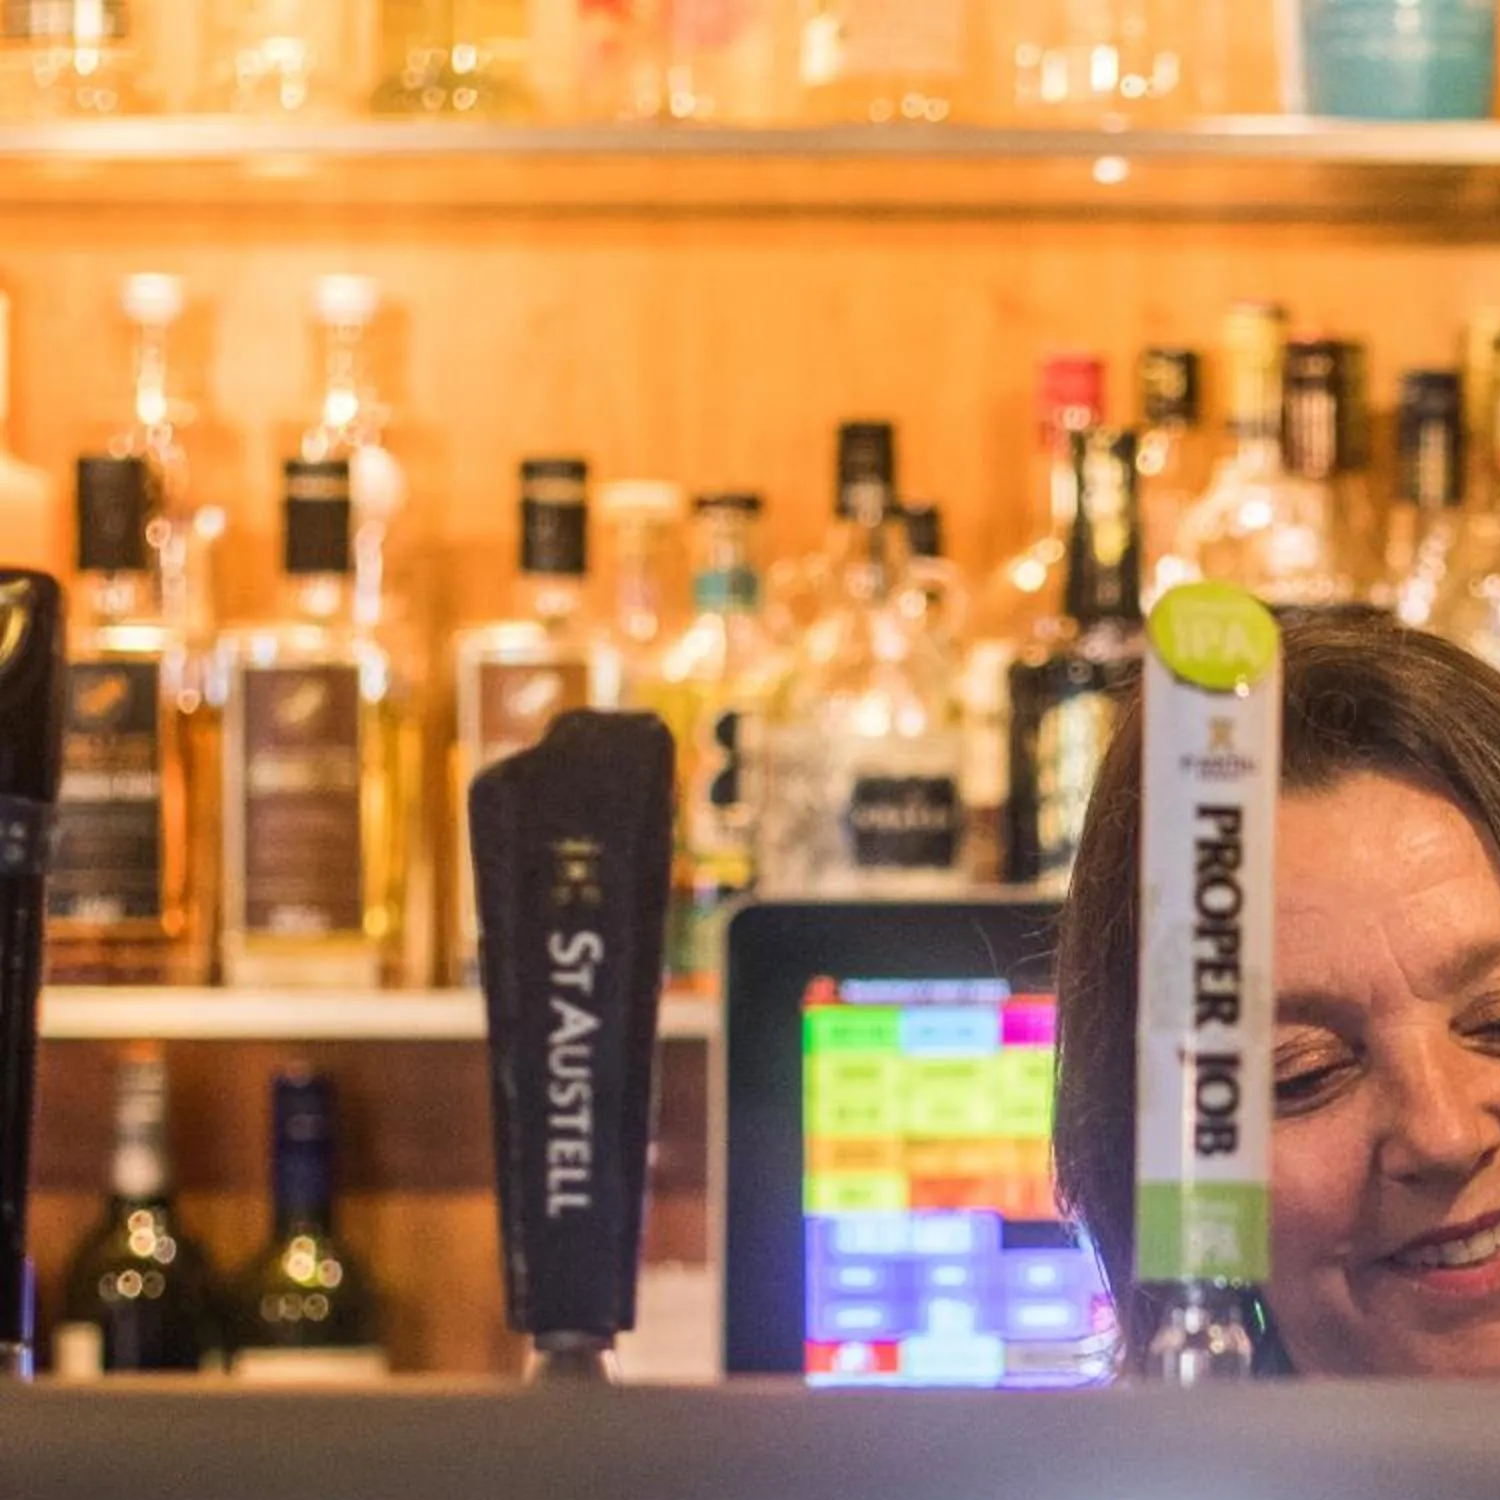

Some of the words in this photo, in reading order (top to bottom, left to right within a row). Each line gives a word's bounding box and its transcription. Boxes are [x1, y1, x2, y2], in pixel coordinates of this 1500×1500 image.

[1174, 612, 1259, 668] IPA
[548, 930, 605, 994] ST
[1194, 804, 1243, 1029] PROPER
[546, 998, 602, 1217] AUSTELL
[1178, 1050, 1241, 1157] JOB
